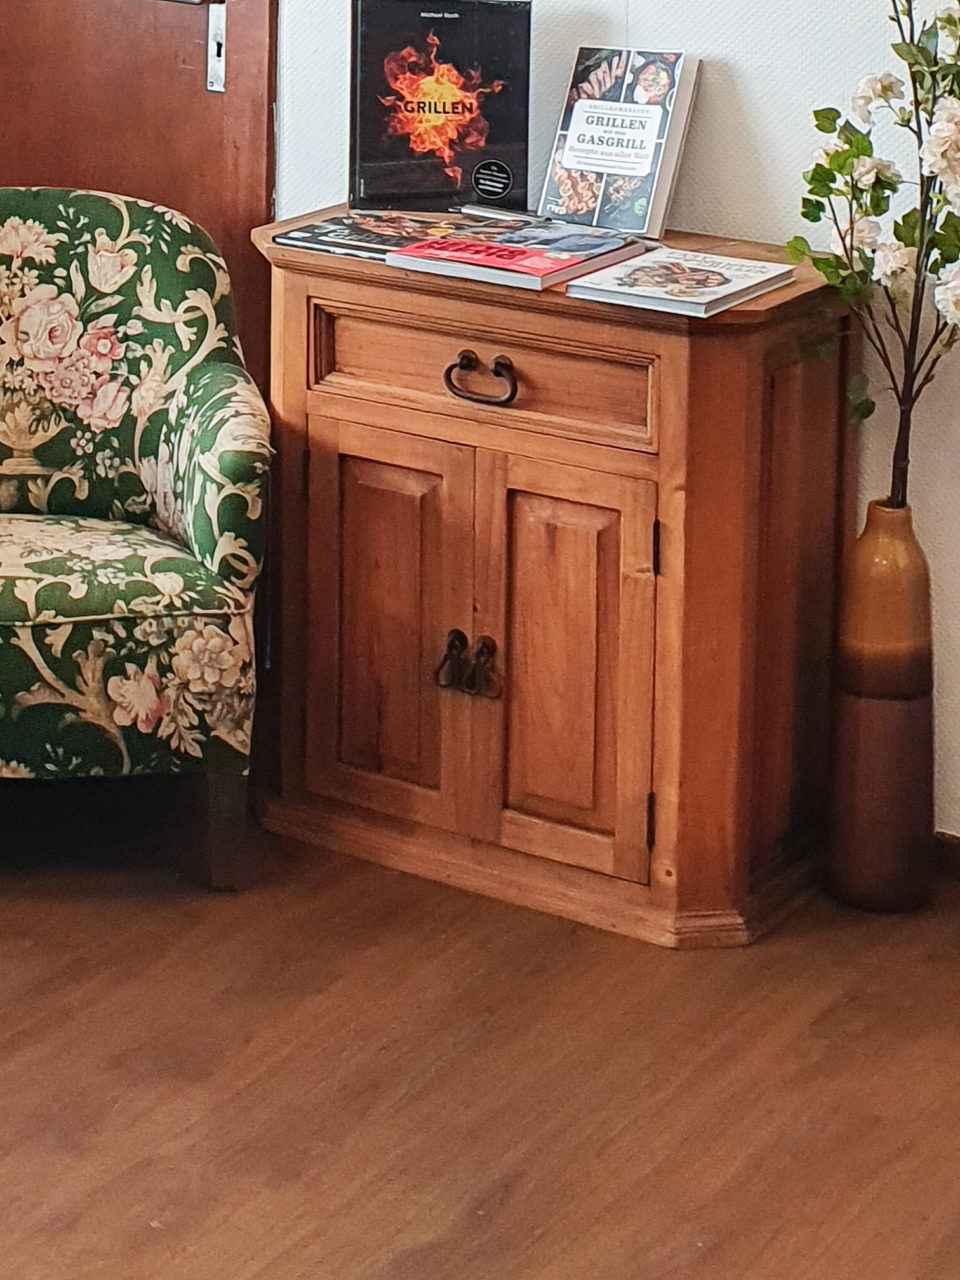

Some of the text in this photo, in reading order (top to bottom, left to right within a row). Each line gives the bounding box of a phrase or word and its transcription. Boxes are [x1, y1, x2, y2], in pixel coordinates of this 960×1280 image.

[404, 101, 473, 115] GRILLEN
[585, 115, 647, 130] GRILLEN
[577, 133, 647, 150] GASGRILL
